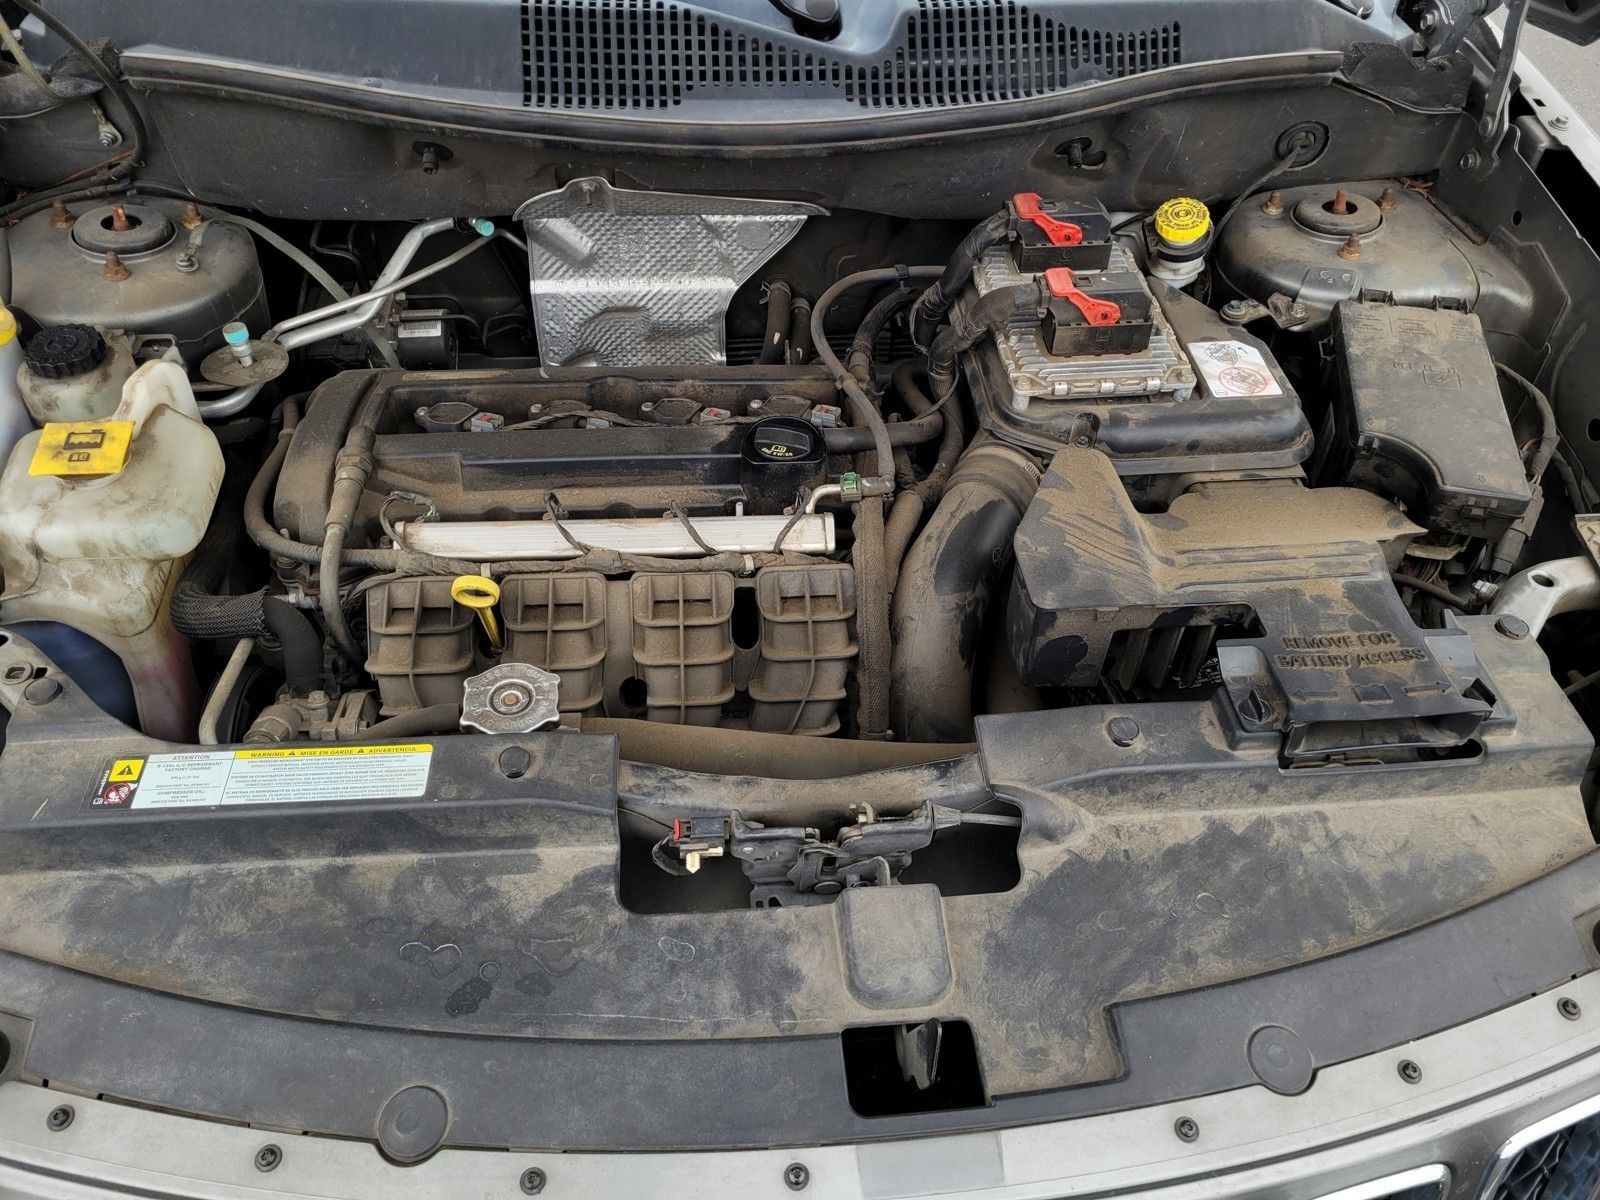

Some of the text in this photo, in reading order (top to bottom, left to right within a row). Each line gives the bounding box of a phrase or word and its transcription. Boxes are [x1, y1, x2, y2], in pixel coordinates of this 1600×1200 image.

[1282, 631, 1396, 649] REMOVE FOR
[1277, 649, 1427, 667] BATTERY ACCESS
